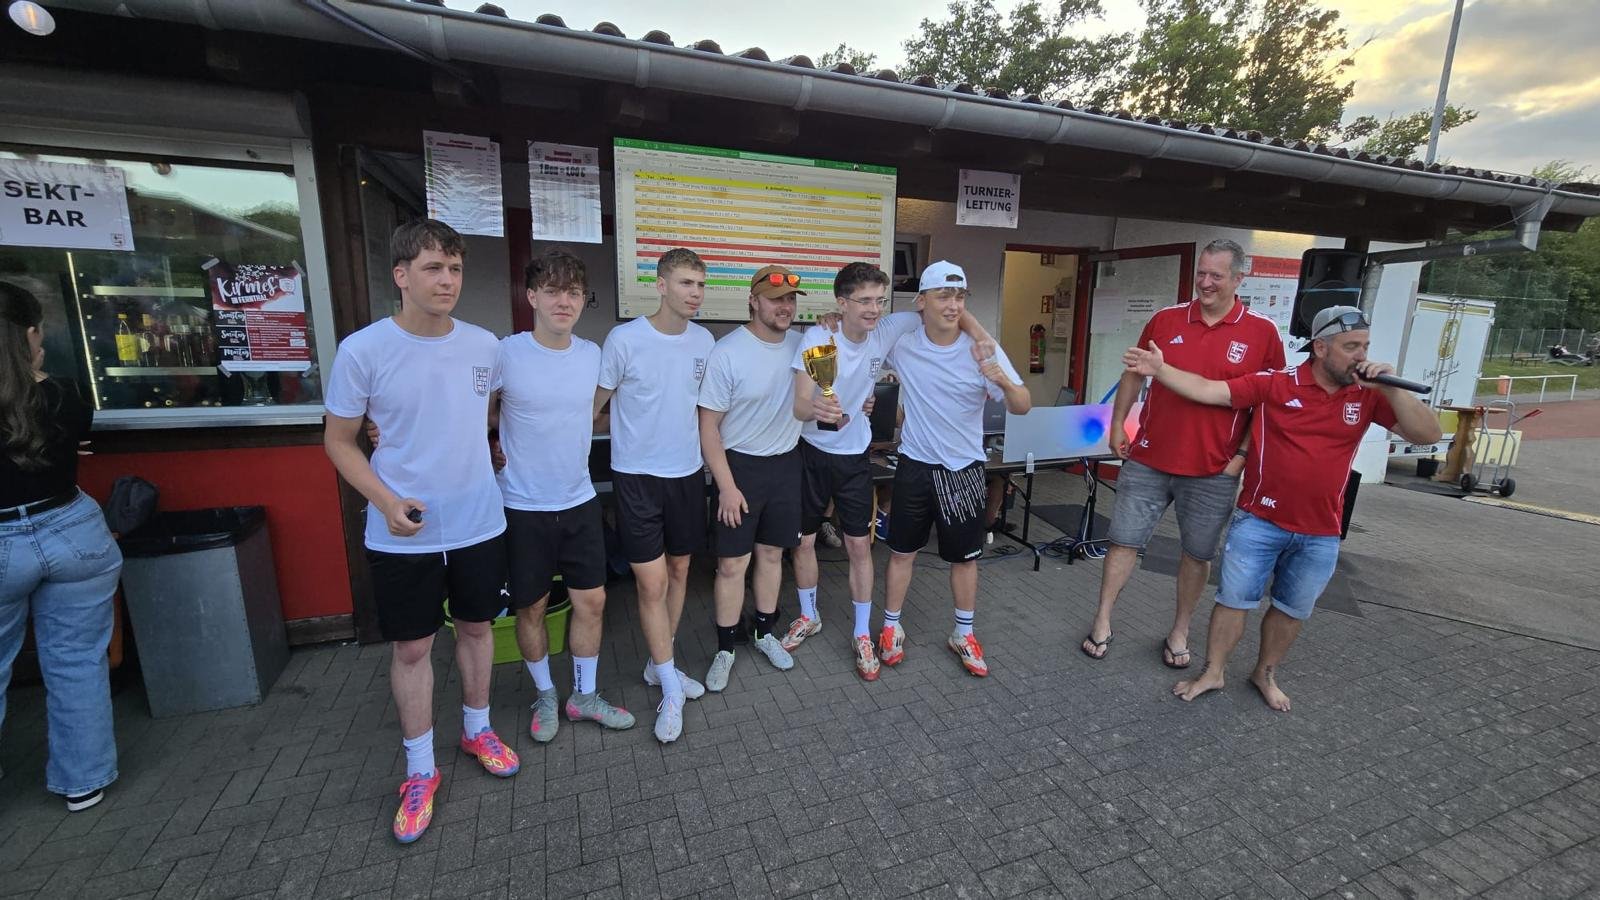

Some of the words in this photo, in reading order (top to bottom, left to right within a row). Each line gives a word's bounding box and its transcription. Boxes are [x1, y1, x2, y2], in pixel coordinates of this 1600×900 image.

[4, 180, 94, 201] SEKT-
[964, 185, 1015, 198] TURNIER-
[966, 200, 1012, 212] LEITUNG
[23, 207, 88, 227] BAR
[217, 276, 278, 302] Kirmes
[1261, 496, 1277, 508] MK
